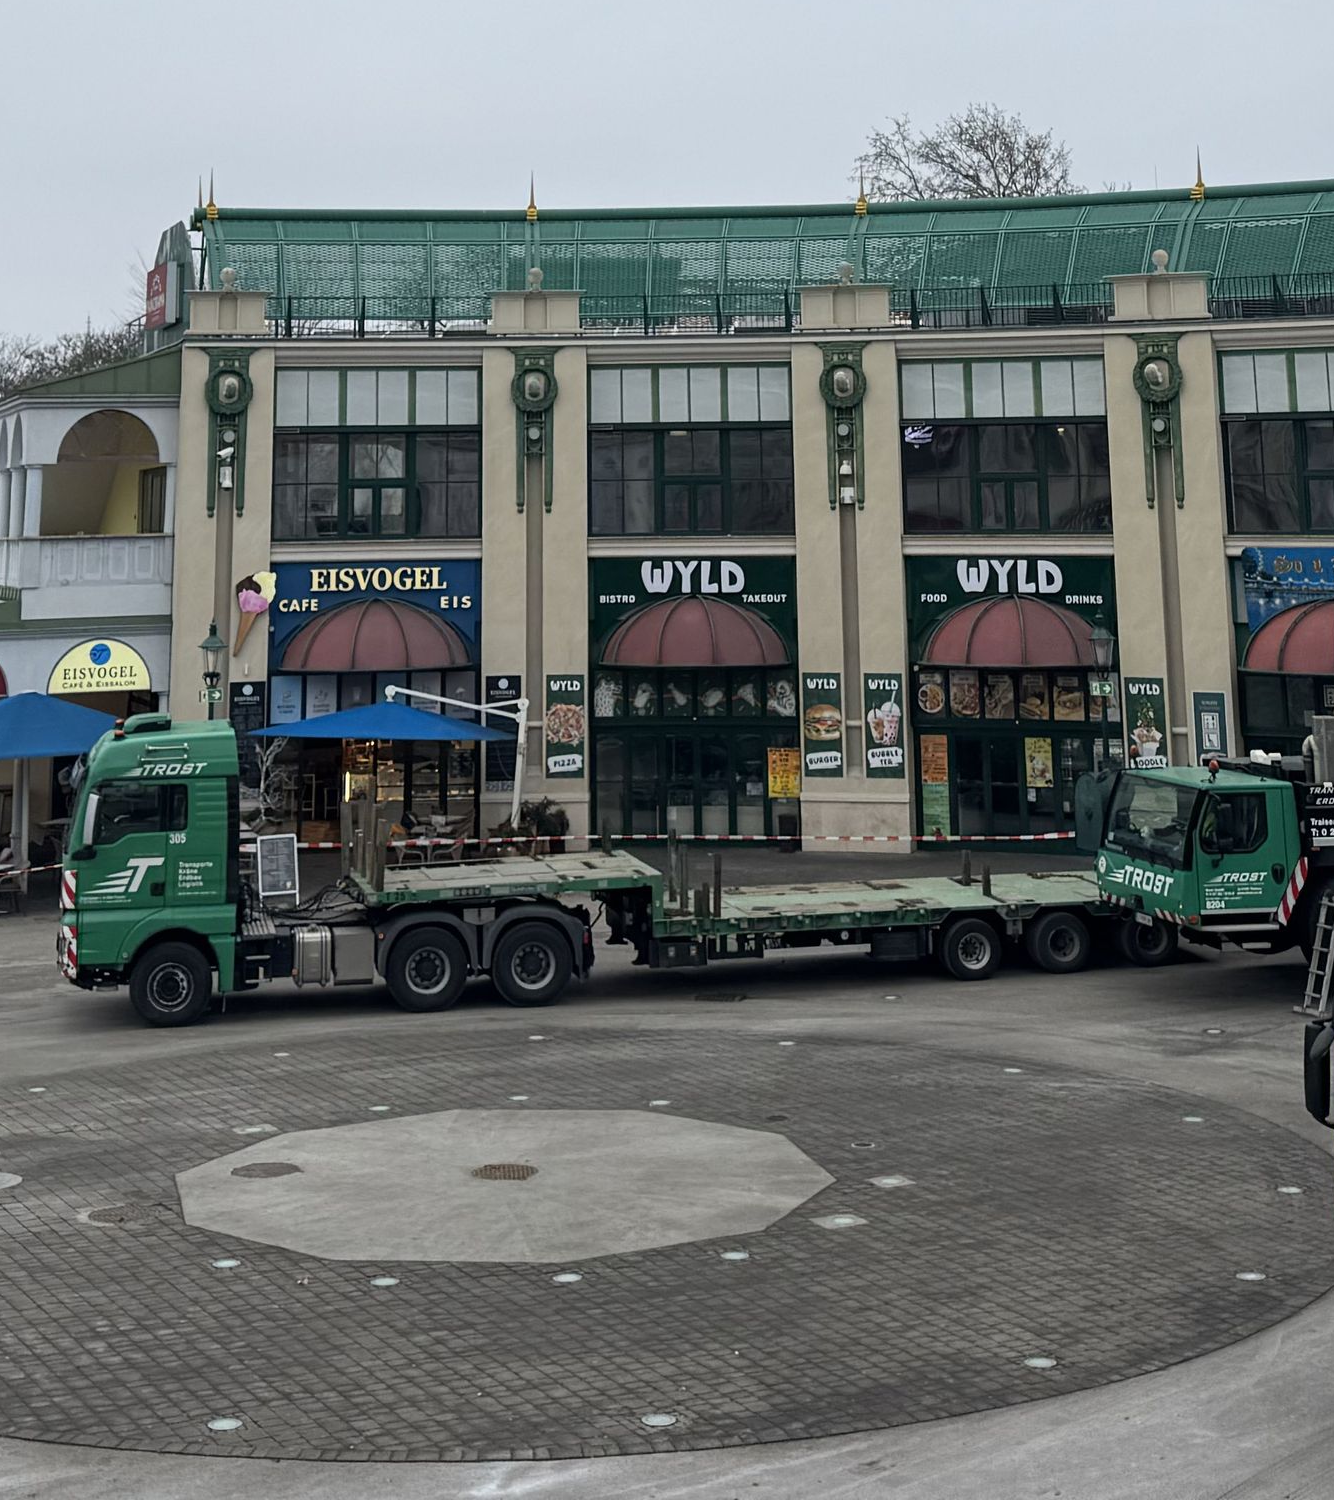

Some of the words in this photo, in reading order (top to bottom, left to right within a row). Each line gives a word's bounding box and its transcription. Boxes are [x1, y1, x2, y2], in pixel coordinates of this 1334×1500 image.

[310, 567, 447, 592] EISVOGEL
[641, 560, 745, 593] WYLD
[956, 559, 1063, 594] WYLD
[278, 598, 319, 612] CAFE
[440, 596, 472, 609] EIS
[599, 595, 636, 603] BISTRO
[742, 594, 787, 603] TAKEOUT
[921, 594, 947, 603] FOOD
[1065, 595, 1103, 604] DRINKS
[63, 665, 137, 680] EISVOGEL
[550, 680, 581, 691] WYLD
[807, 678, 837, 690] WYLD
[868, 679, 899, 690] WYLD
[1129, 683, 1160, 696] WYLD
[871, 749, 899, 759] BUBBLE
[553, 758, 577, 768] PIZZA
[808, 756, 839, 765] BURGER
[1133, 758, 1165, 767] OODLE
[141, 762, 208, 776] TROST
[169, 833, 187, 844] 305
[1124, 864, 1175, 897] TROST
[1222, 871, 1267, 882] TROST
